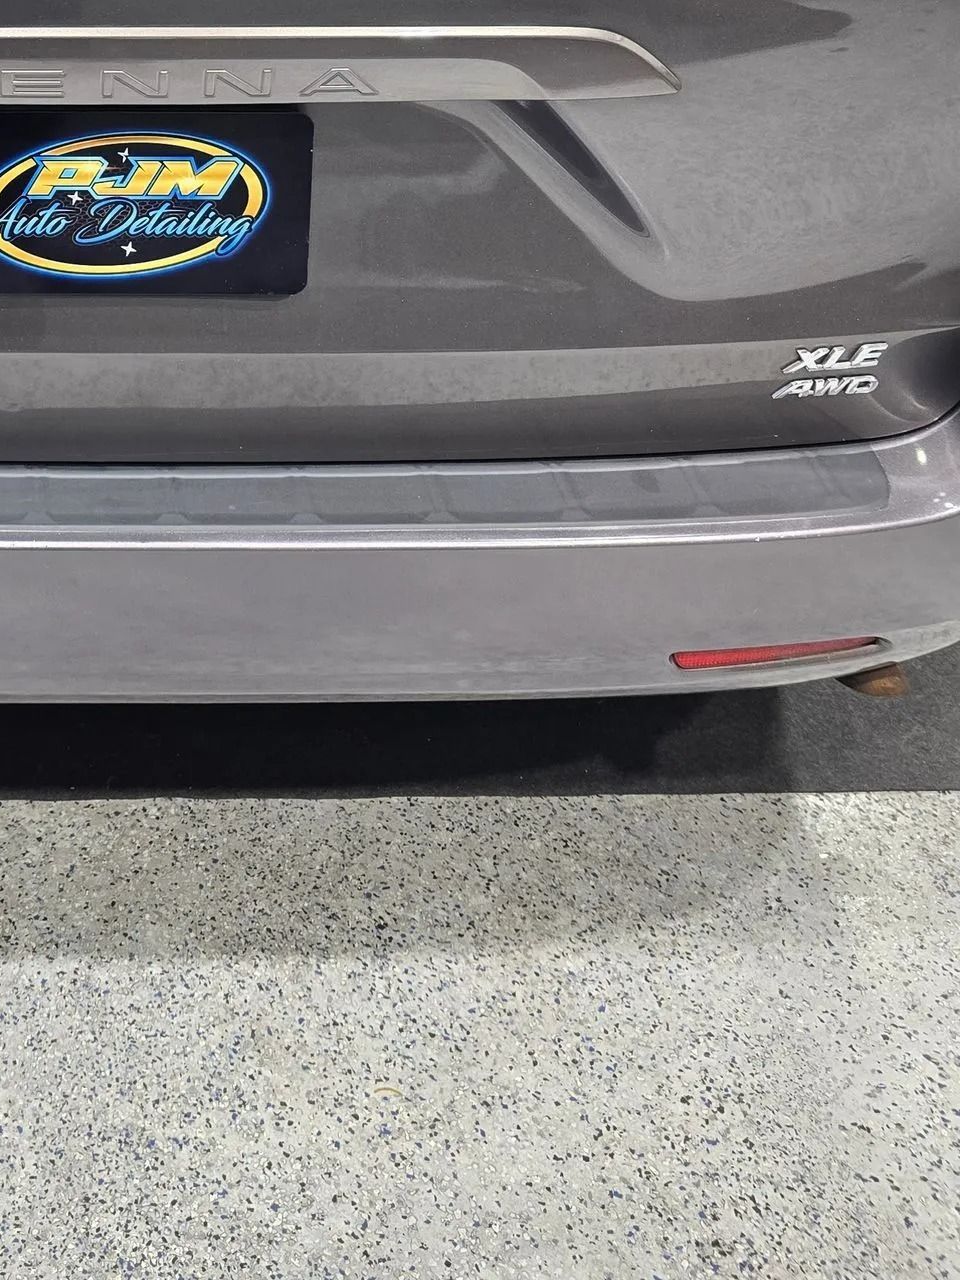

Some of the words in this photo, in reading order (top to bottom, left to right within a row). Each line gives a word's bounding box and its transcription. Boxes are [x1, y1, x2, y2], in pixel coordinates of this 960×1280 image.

[23, 155, 240, 199] PJM
[75, 196, 254, 256] Detailing
[781, 341, 888, 374] XLE
[771, 374, 879, 399] AWD
